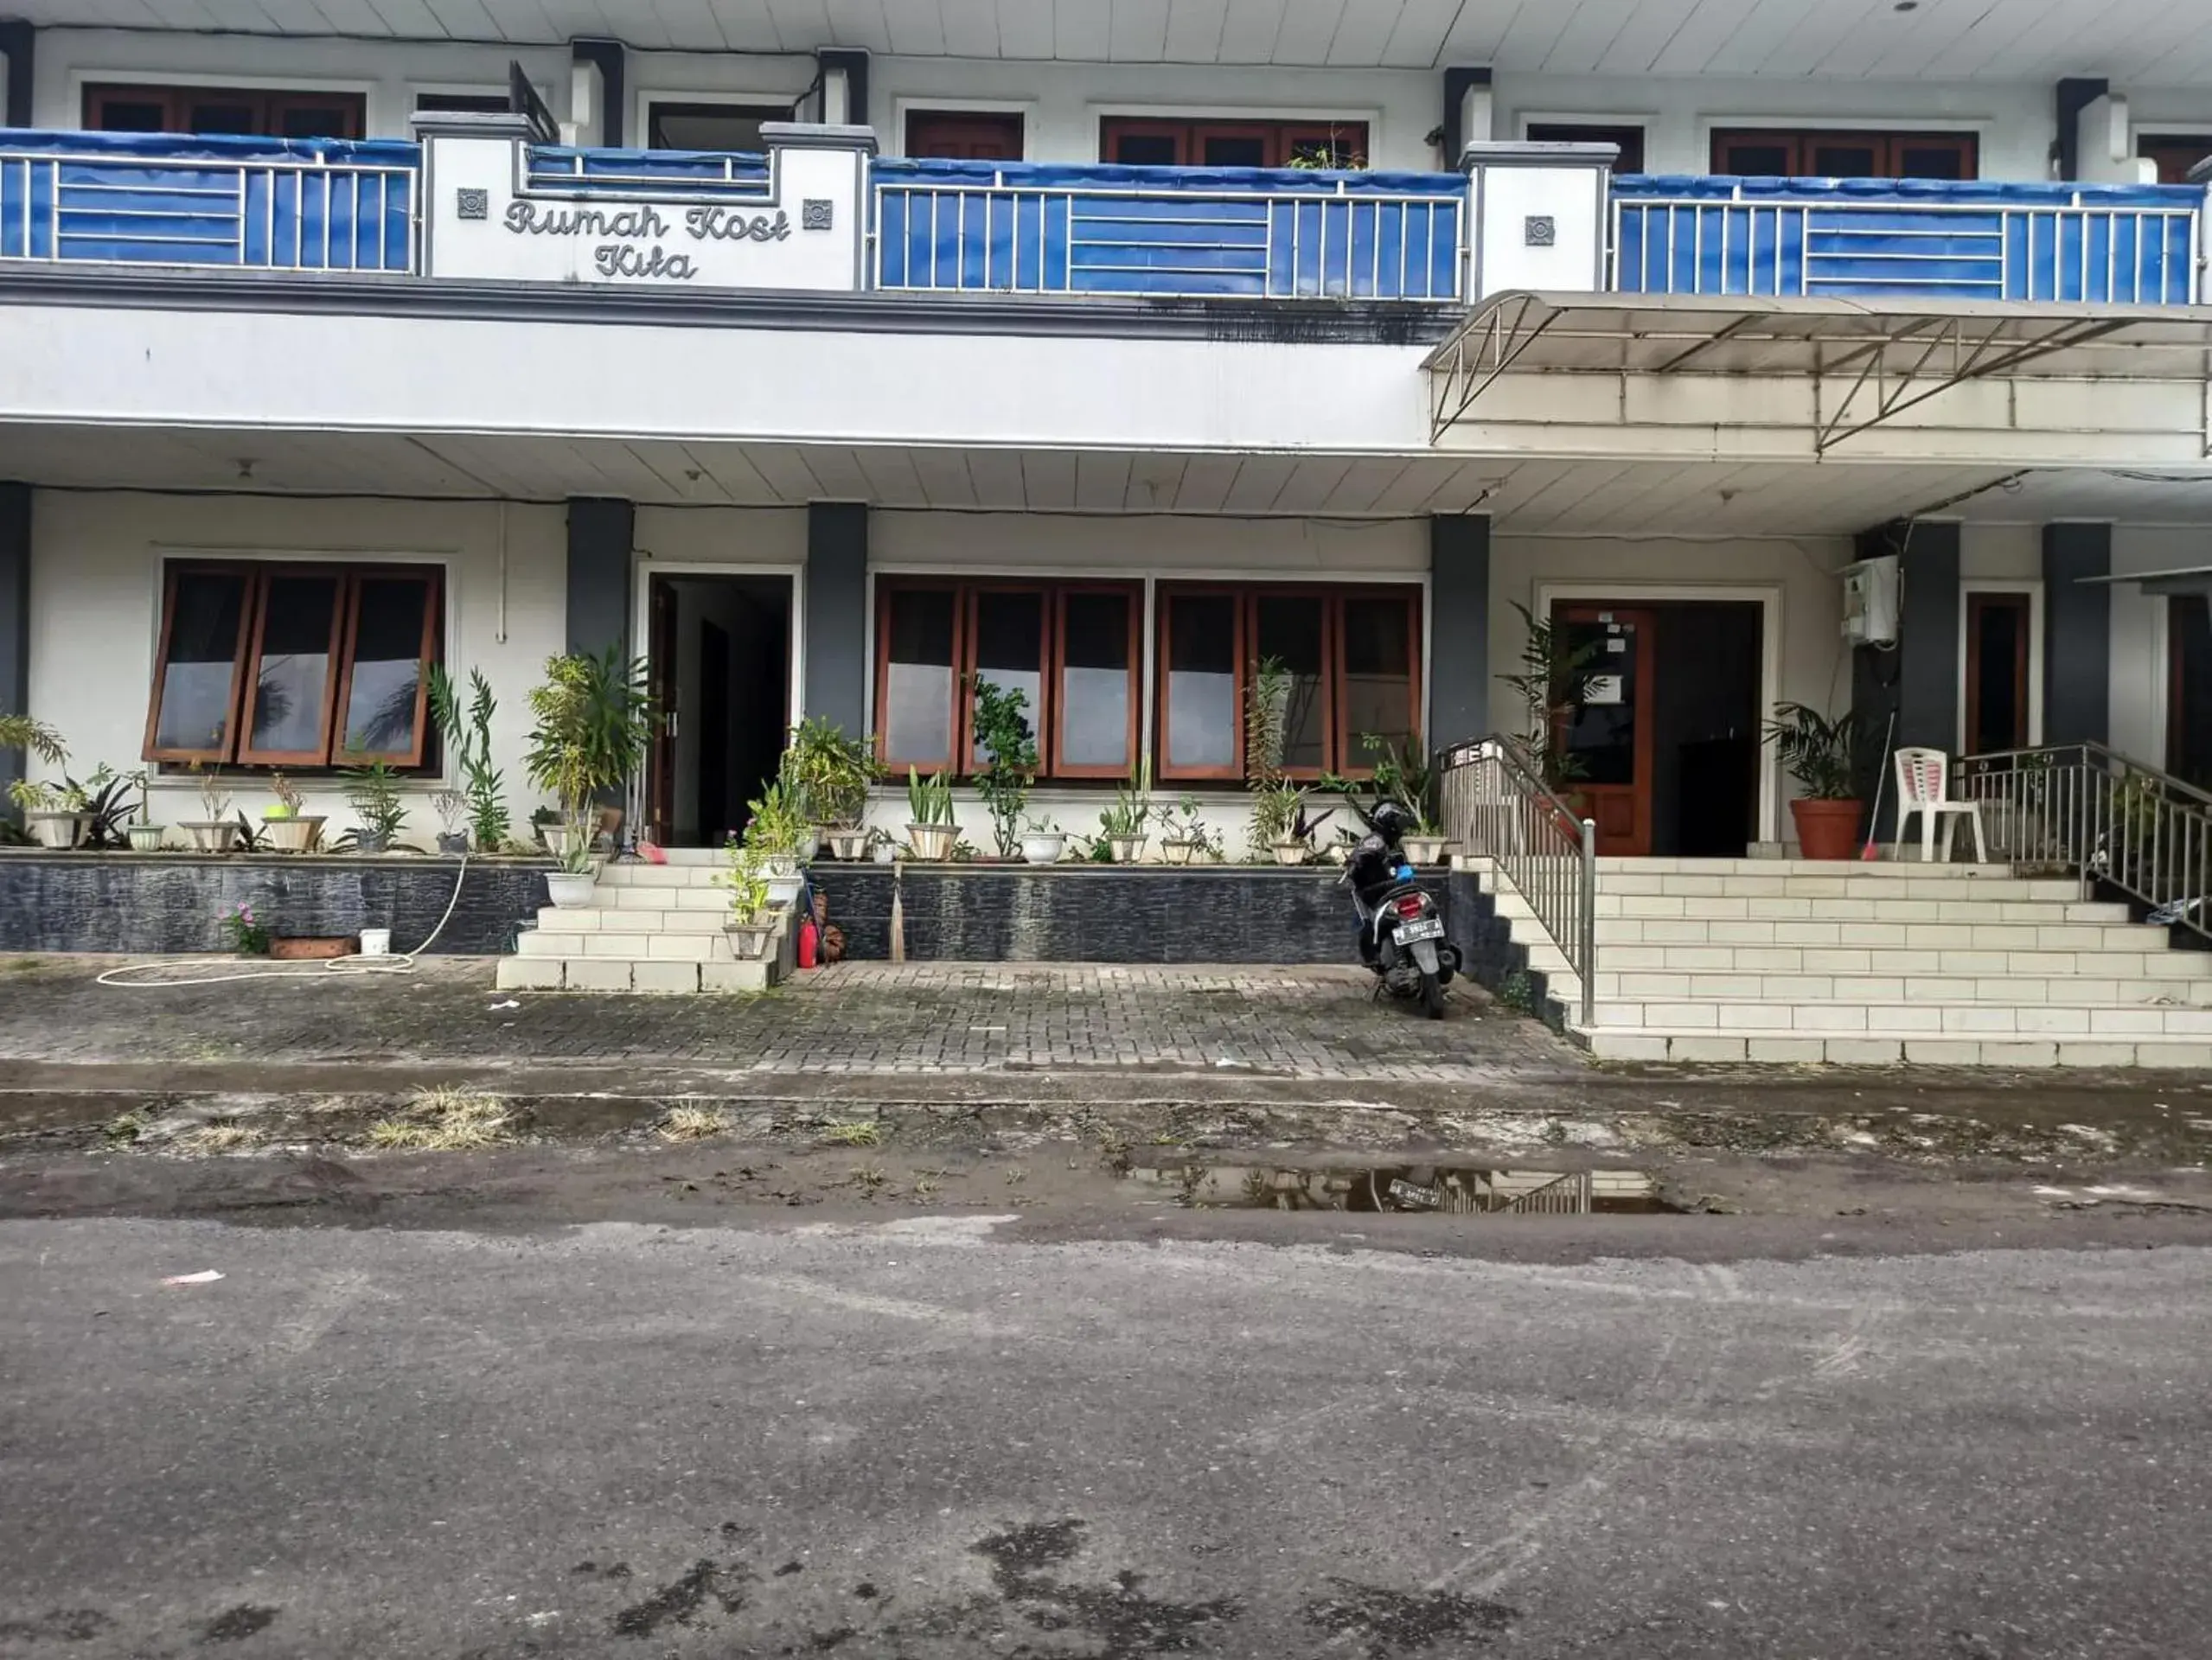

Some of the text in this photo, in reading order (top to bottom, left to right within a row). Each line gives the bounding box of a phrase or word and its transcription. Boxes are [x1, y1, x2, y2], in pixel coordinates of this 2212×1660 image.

[504, 200, 791, 241] Rumah Kost
[596, 245, 698, 279] Kita
